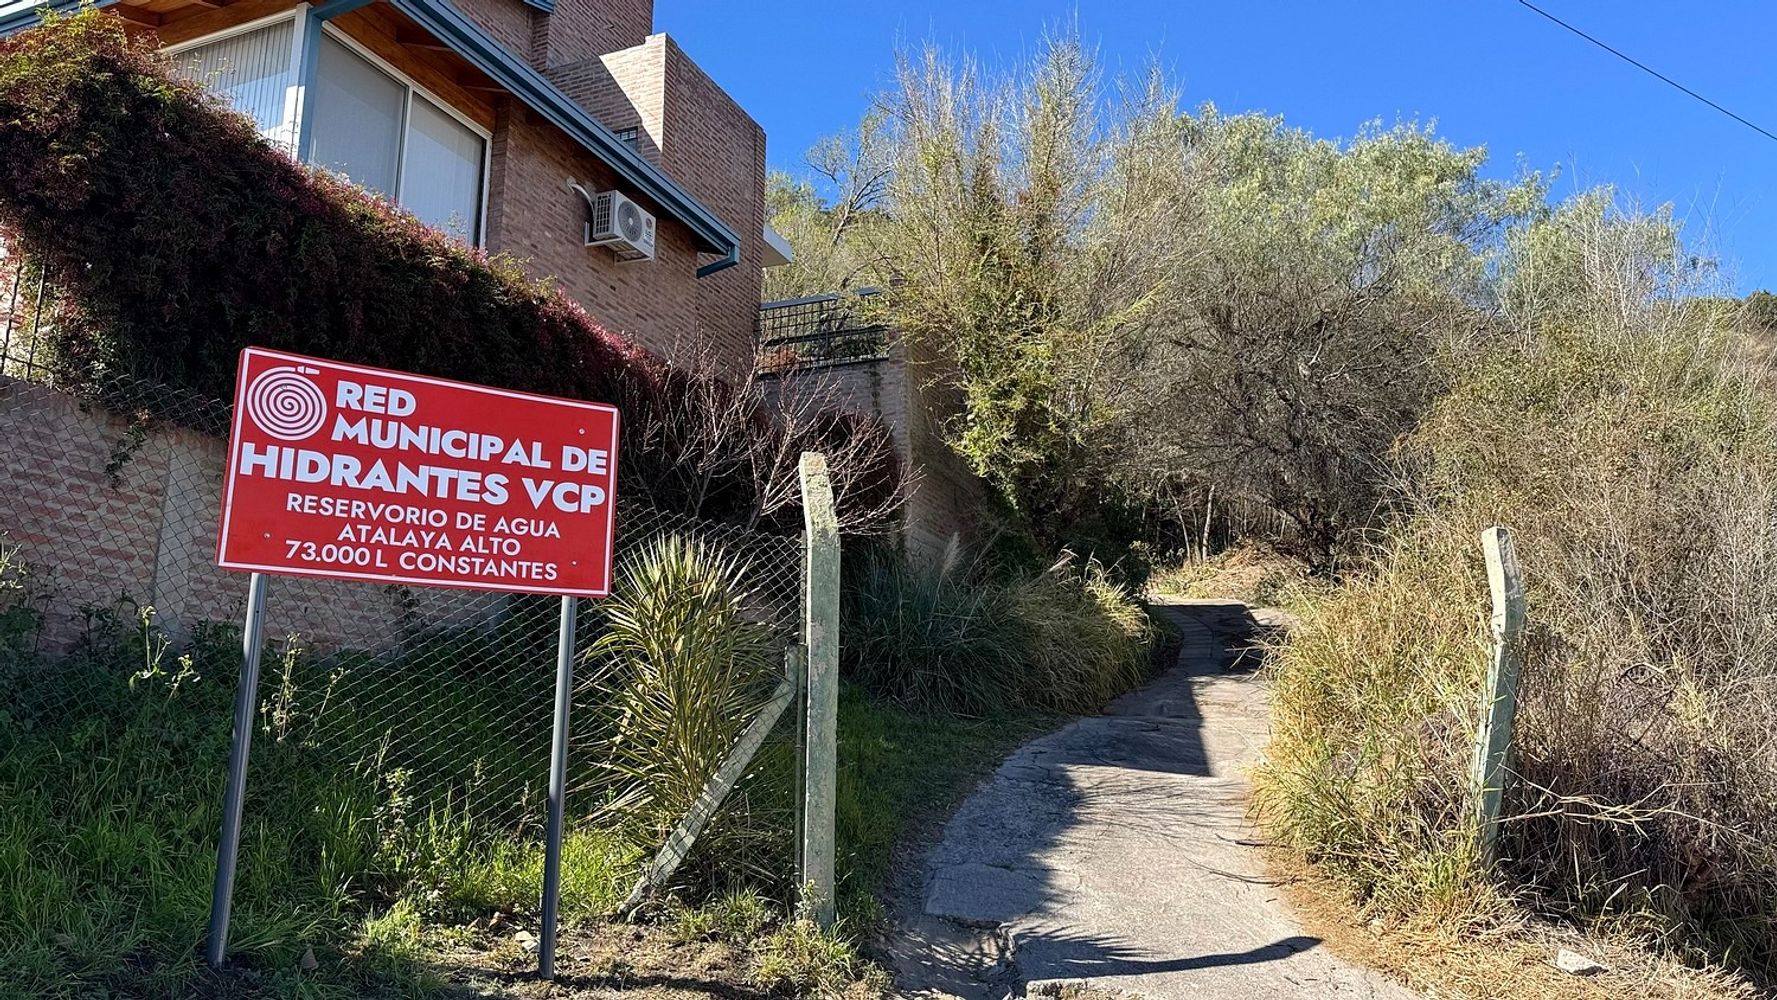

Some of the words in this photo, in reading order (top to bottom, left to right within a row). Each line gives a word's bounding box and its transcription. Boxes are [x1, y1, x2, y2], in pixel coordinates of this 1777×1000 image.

[335, 380, 416, 417] RED
[331, 416, 551, 469] MUNICIPAL
[562, 445, 608, 476] DE
[240, 442, 508, 506] HIDRANTES
[522, 478, 606, 514] VCP
[286, 492, 448, 528] RESERVORIO
[456, 512, 485, 532] DE
[493, 516, 560, 539] AGUA
[285, 540, 370, 567] 73.000
[375, 548, 388, 569] L
[399, 551, 558, 580] CONSTANTES
[337, 523, 453, 551] ATALAYA
[460, 534, 520, 556] ALTO
